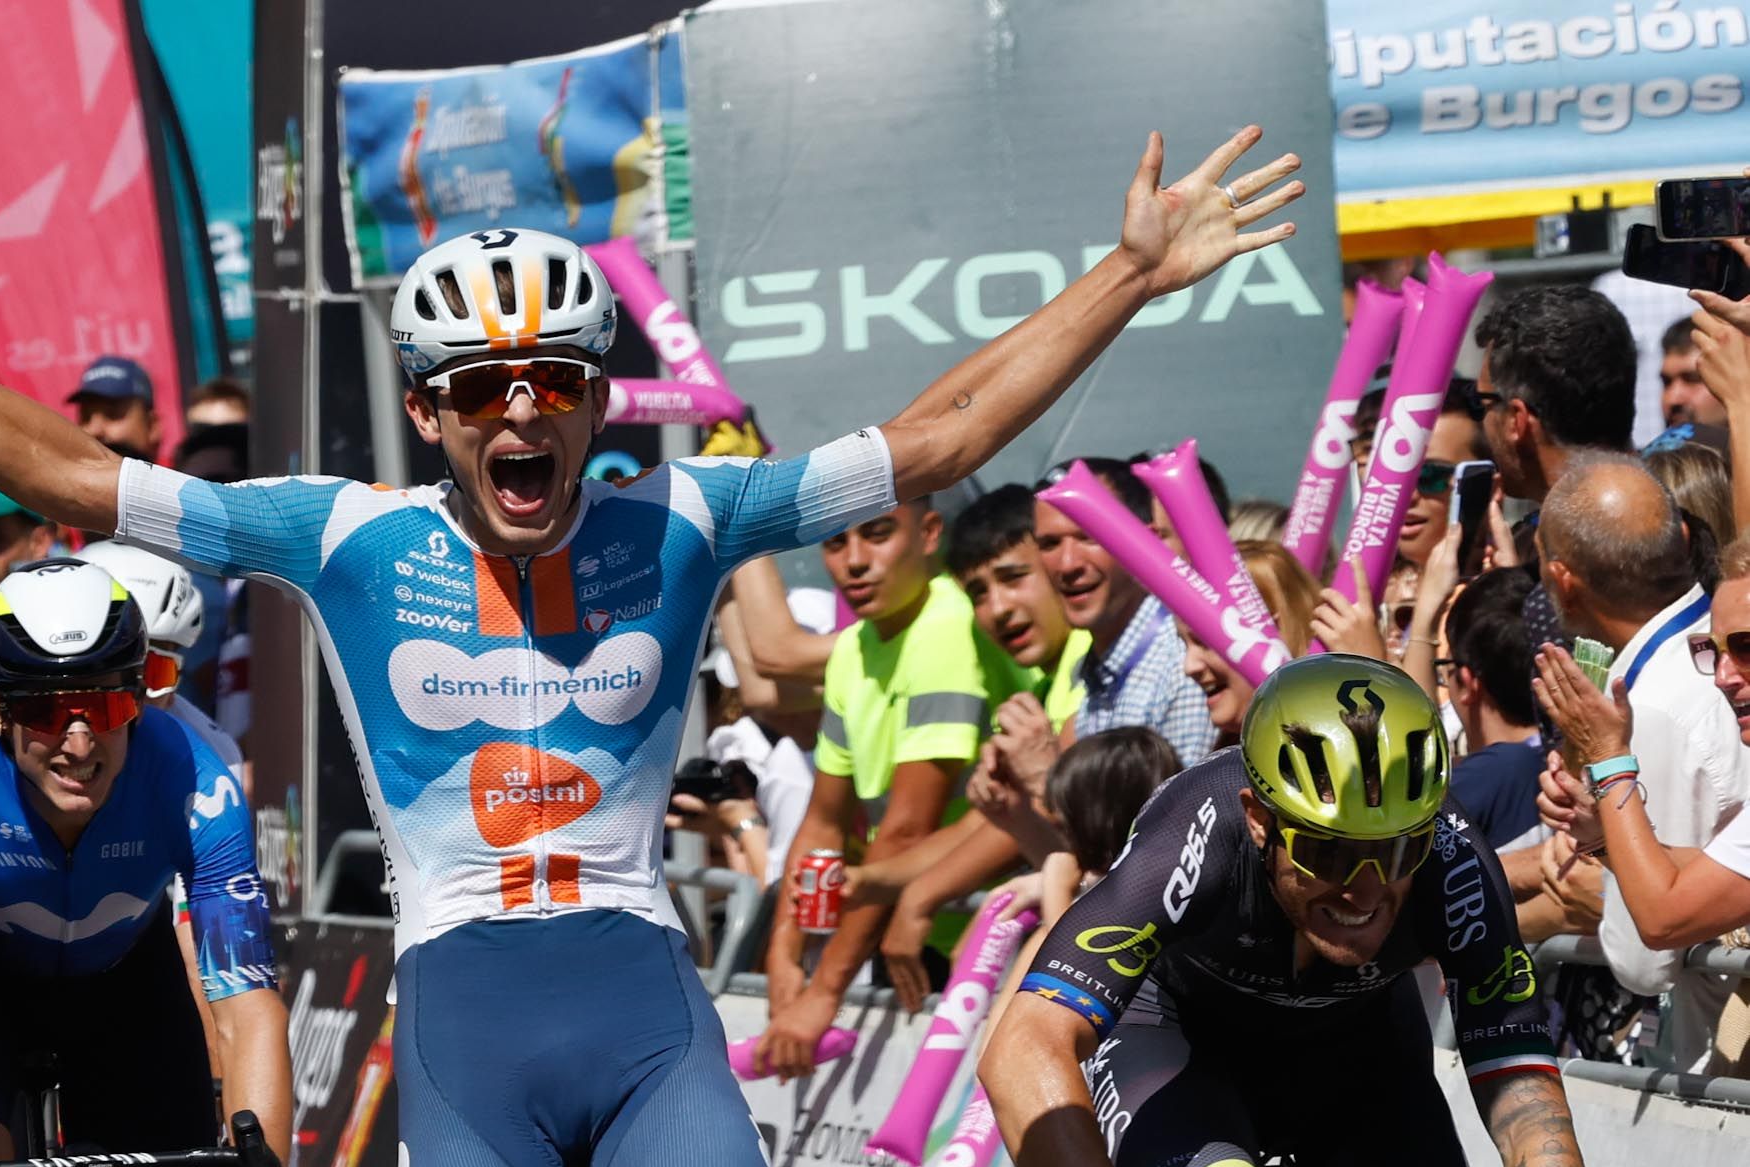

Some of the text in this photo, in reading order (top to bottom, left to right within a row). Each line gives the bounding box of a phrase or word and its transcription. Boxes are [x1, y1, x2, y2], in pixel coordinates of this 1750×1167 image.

[1330, 0, 1748, 88] iputación
[1421, 73, 1743, 133] Burgos
[1303, 477, 1336, 535] VUELTA
[1365, 484, 1402, 547] VUELTA
[408, 550, 469, 573] SCOTT
[417, 569, 471, 592] webex
[604, 566, 652, 592] Logistics
[416, 593, 473, 612] nexeye
[612, 591, 663, 622] Nalini
[422, 664, 642, 697] dsm-firmenich
[485, 781, 584, 814] postnl
[100, 840, 146, 859] GOBIK
[1162, 797, 1218, 925] Q36.5
[1443, 854, 1488, 953] UBS
